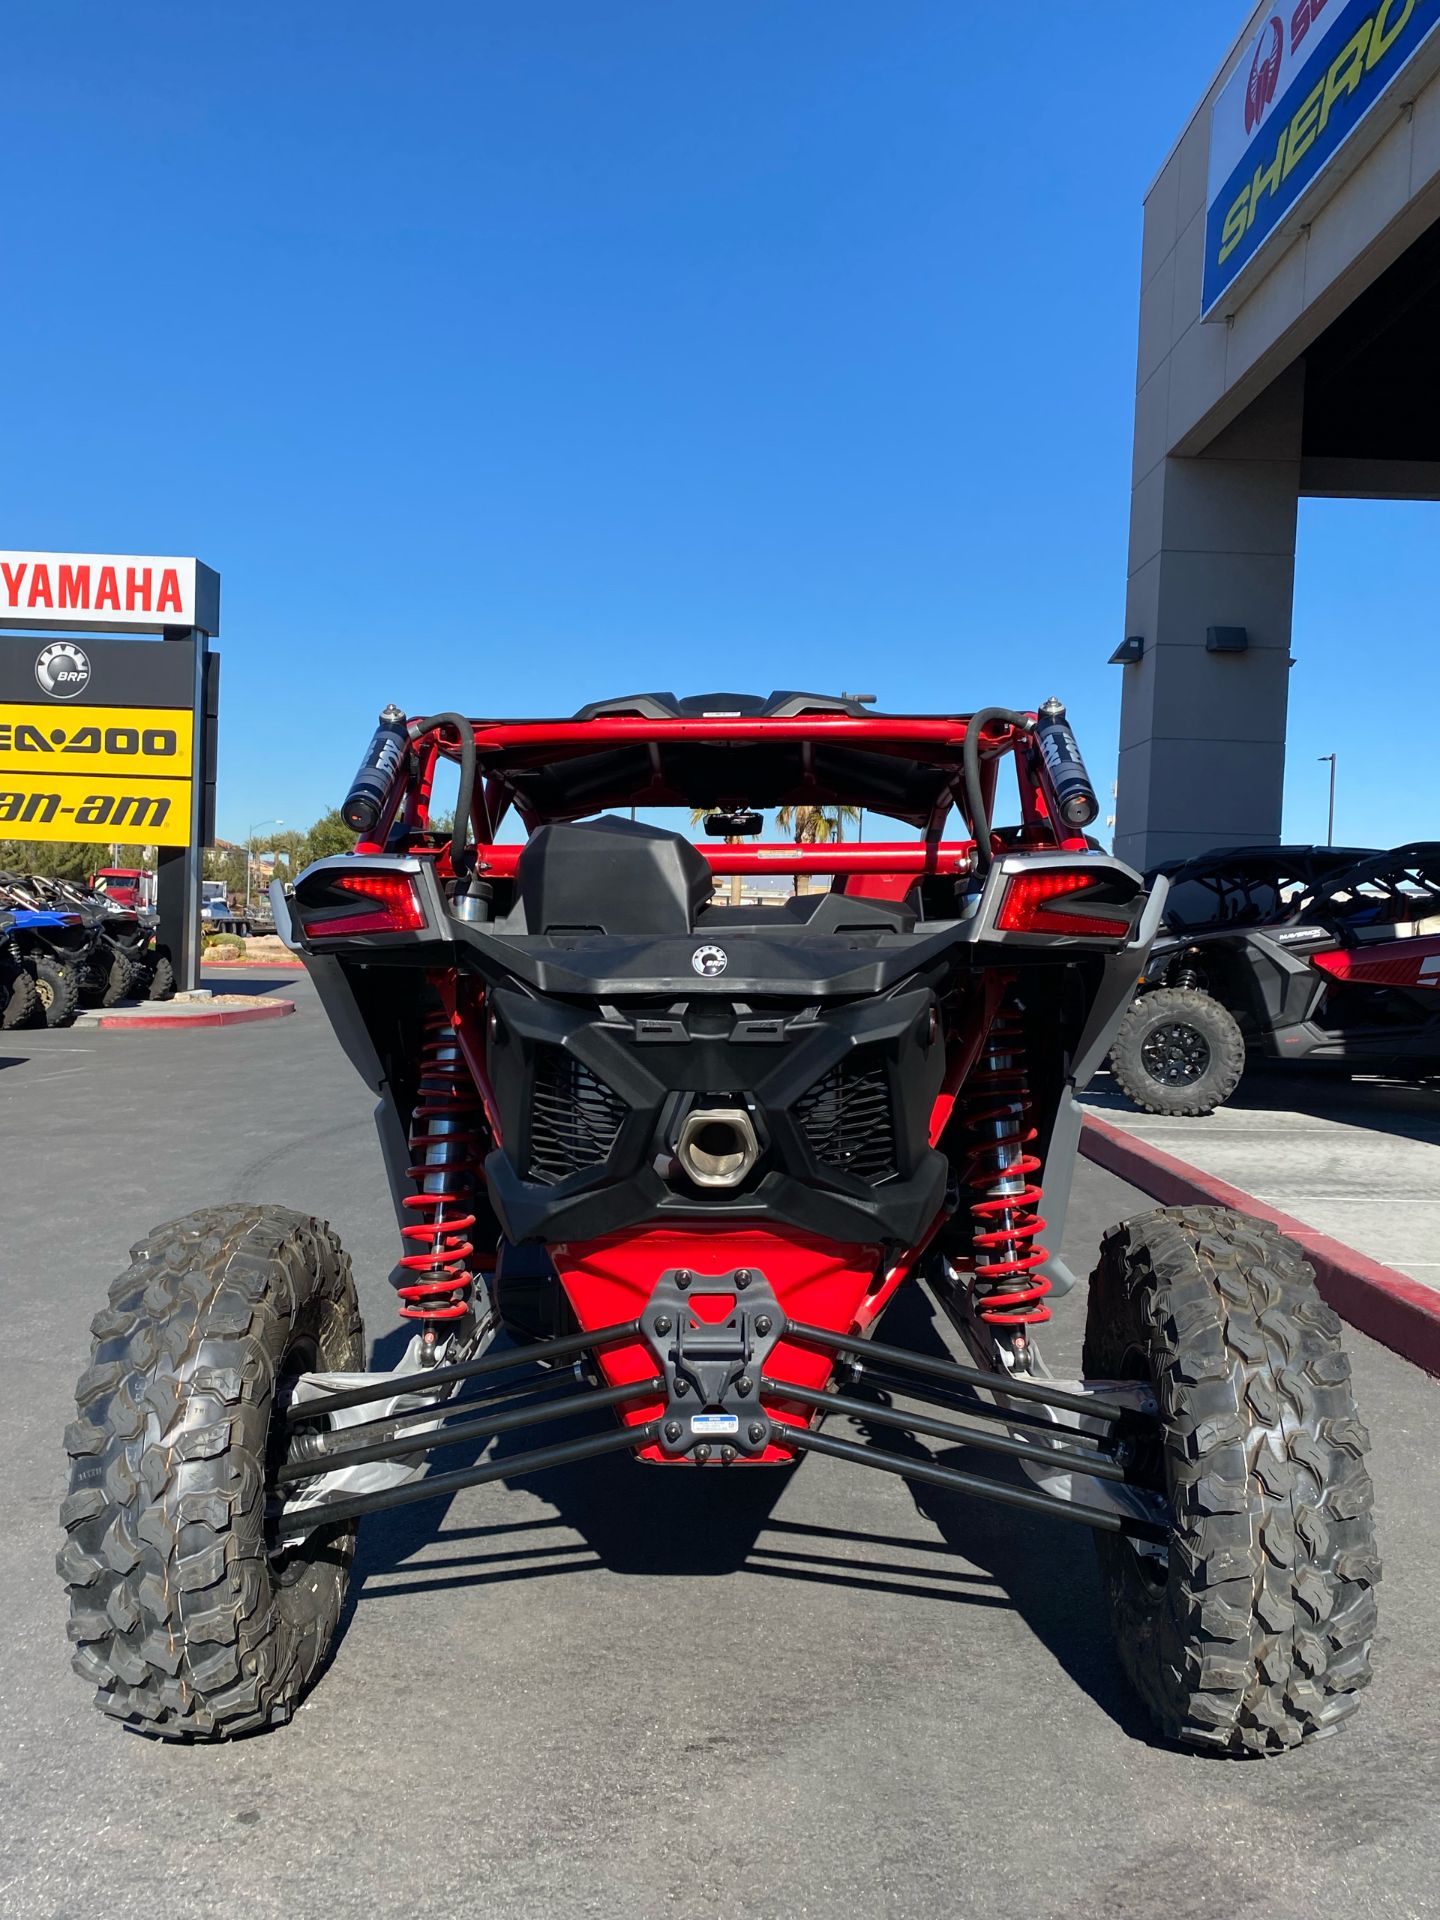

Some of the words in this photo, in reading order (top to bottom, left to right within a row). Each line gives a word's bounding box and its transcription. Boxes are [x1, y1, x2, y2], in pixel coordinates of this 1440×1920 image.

[1218, 0, 1425, 264] SHERC
[1, 562, 183, 613] YAMAHA
[57, 671, 88, 682] BRP
[376, 739, 403, 786] FOX
